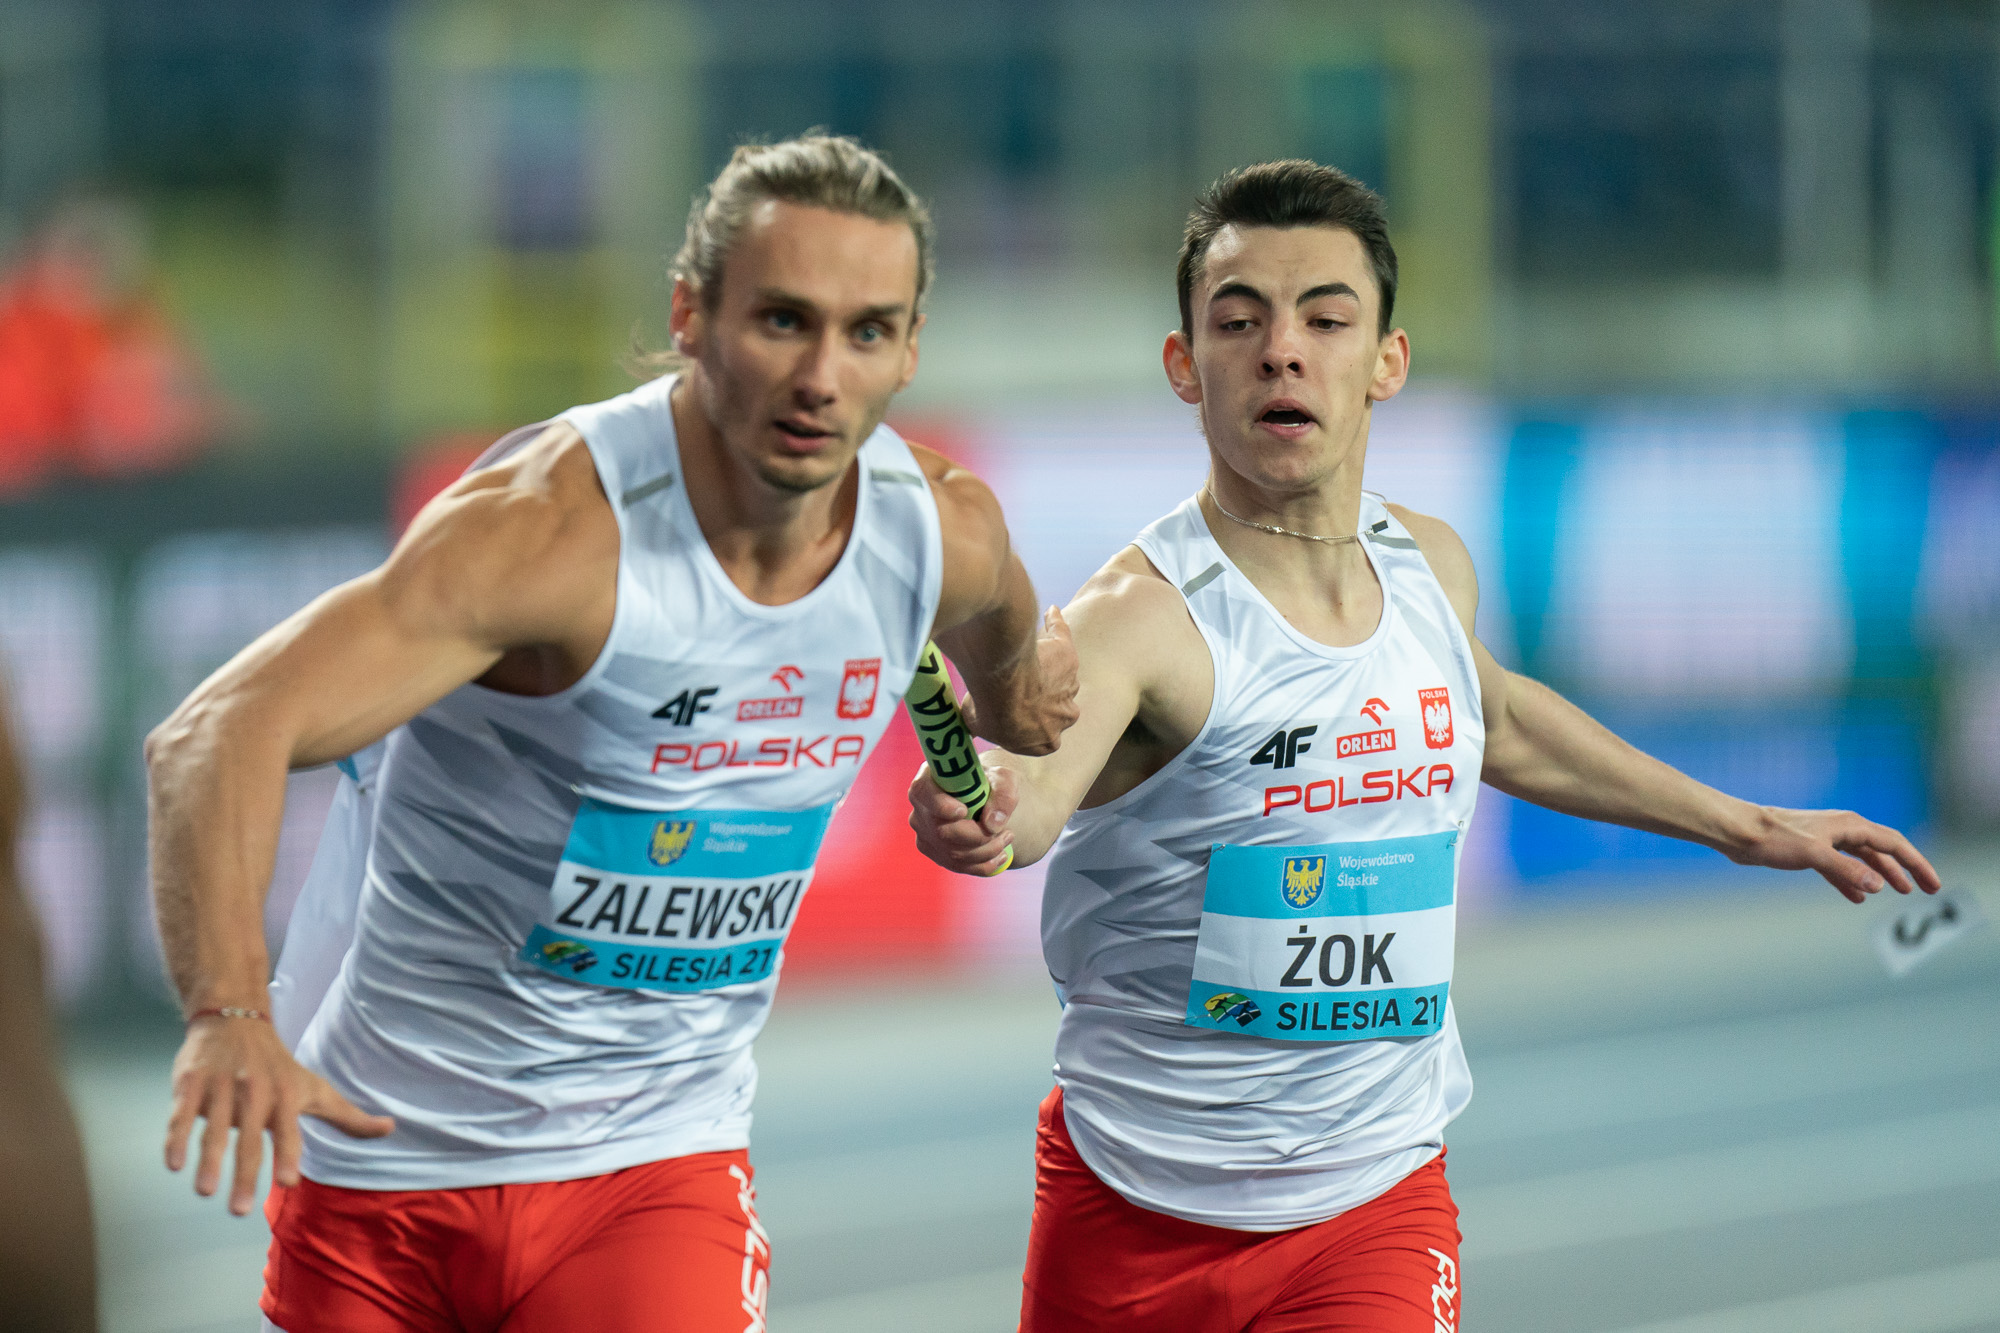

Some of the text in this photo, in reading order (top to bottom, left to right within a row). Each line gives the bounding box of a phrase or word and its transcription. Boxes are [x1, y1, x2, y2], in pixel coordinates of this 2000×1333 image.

[651, 686, 720, 726] 4F
[1420, 689, 1447, 700] POLSKA
[651, 735, 865, 774] POLSKA
[912, 682, 986, 822] ILESIA
[1249, 724, 1318, 770] 4F
[1338, 731, 1394, 756] ORLEN
[1262, 763, 1455, 817] POLSKA
[1336, 871, 1379, 889] Śląskie
[1338, 852, 1415, 870] Województwo
[555, 874, 804, 941] ZALEWSKI
[611, 947, 774, 984] SILESIA 21
[1280, 924, 1397, 988] ŻOK
[1276, 994, 1438, 1032] SILESIA 21
